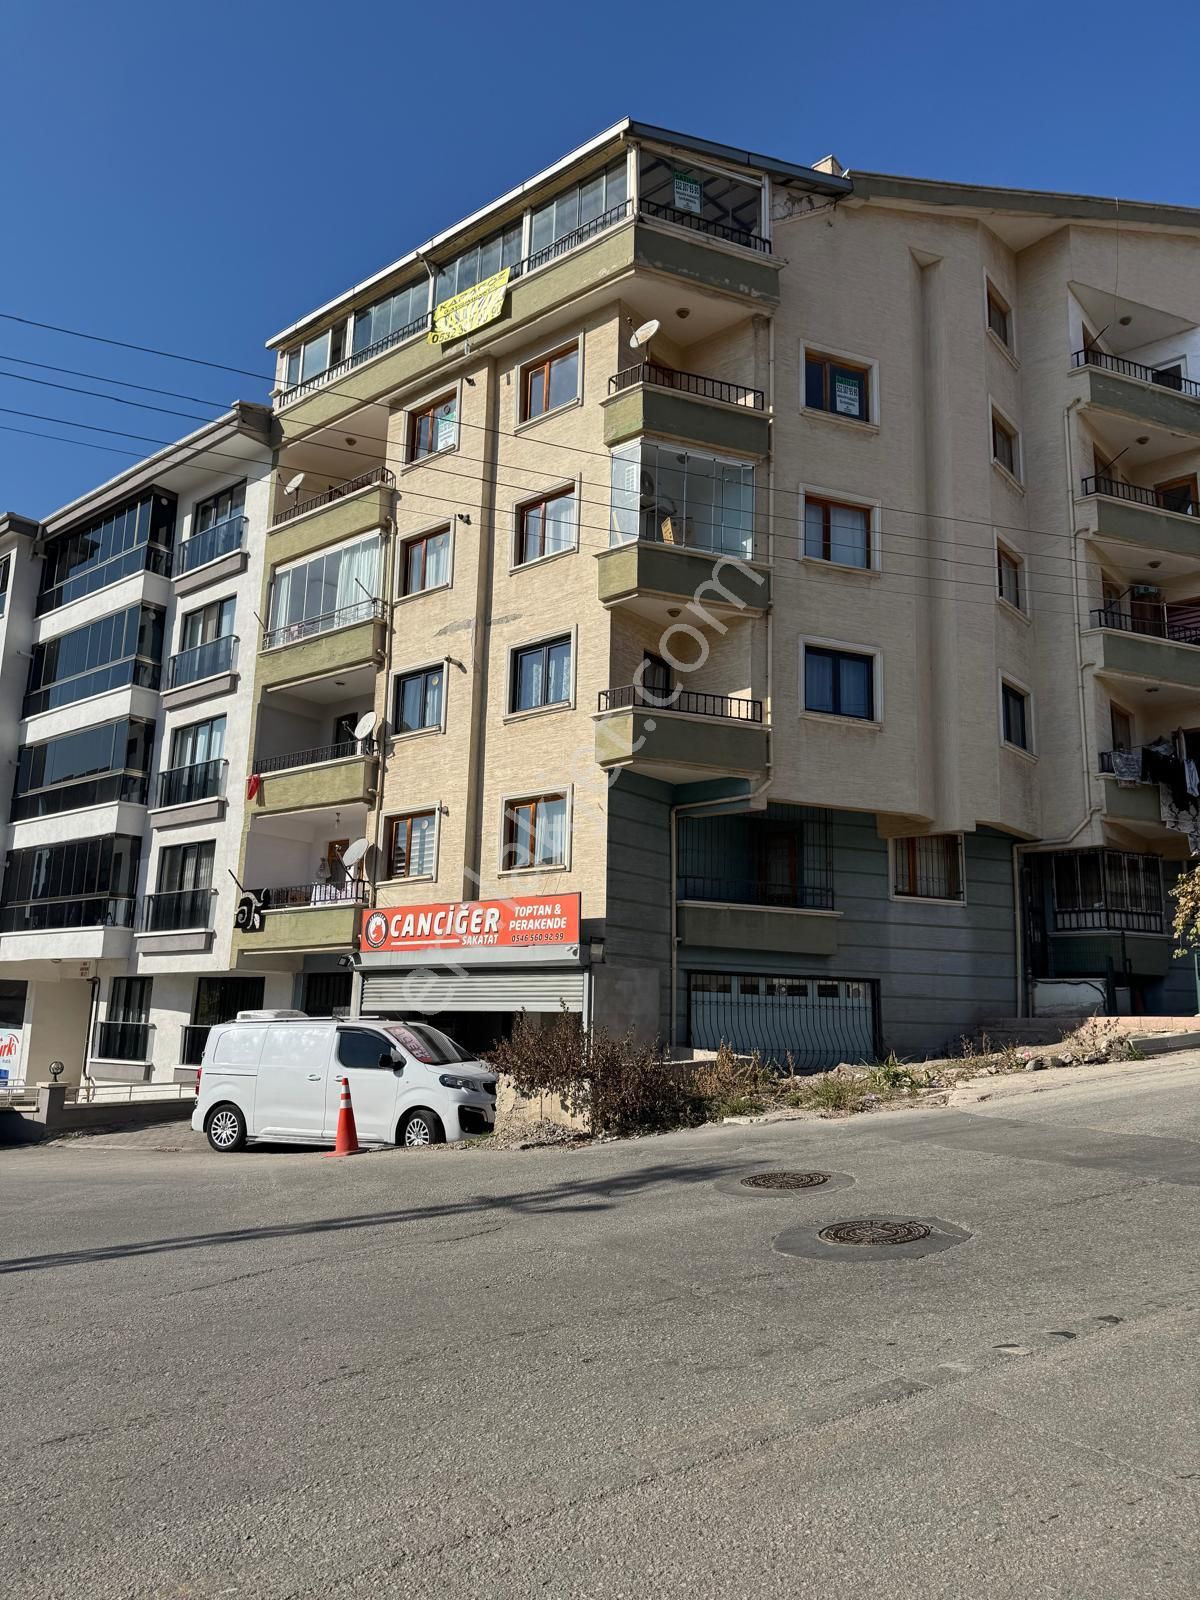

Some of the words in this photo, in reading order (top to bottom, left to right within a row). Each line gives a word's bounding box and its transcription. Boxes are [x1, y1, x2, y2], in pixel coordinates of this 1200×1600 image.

[514, 904, 552, 918] TOPTAN
[554, 903, 561, 915] &
[390, 904, 500, 938] CANCİĞER
[508, 917, 567, 931] PERAKENDE
[461, 934, 499, 946] SAKATAT
[511, 934, 528, 942] 0546
[530, 933, 543, 942] 560
[544, 933, 553, 941] 92
[555, 932, 564, 941] 99
